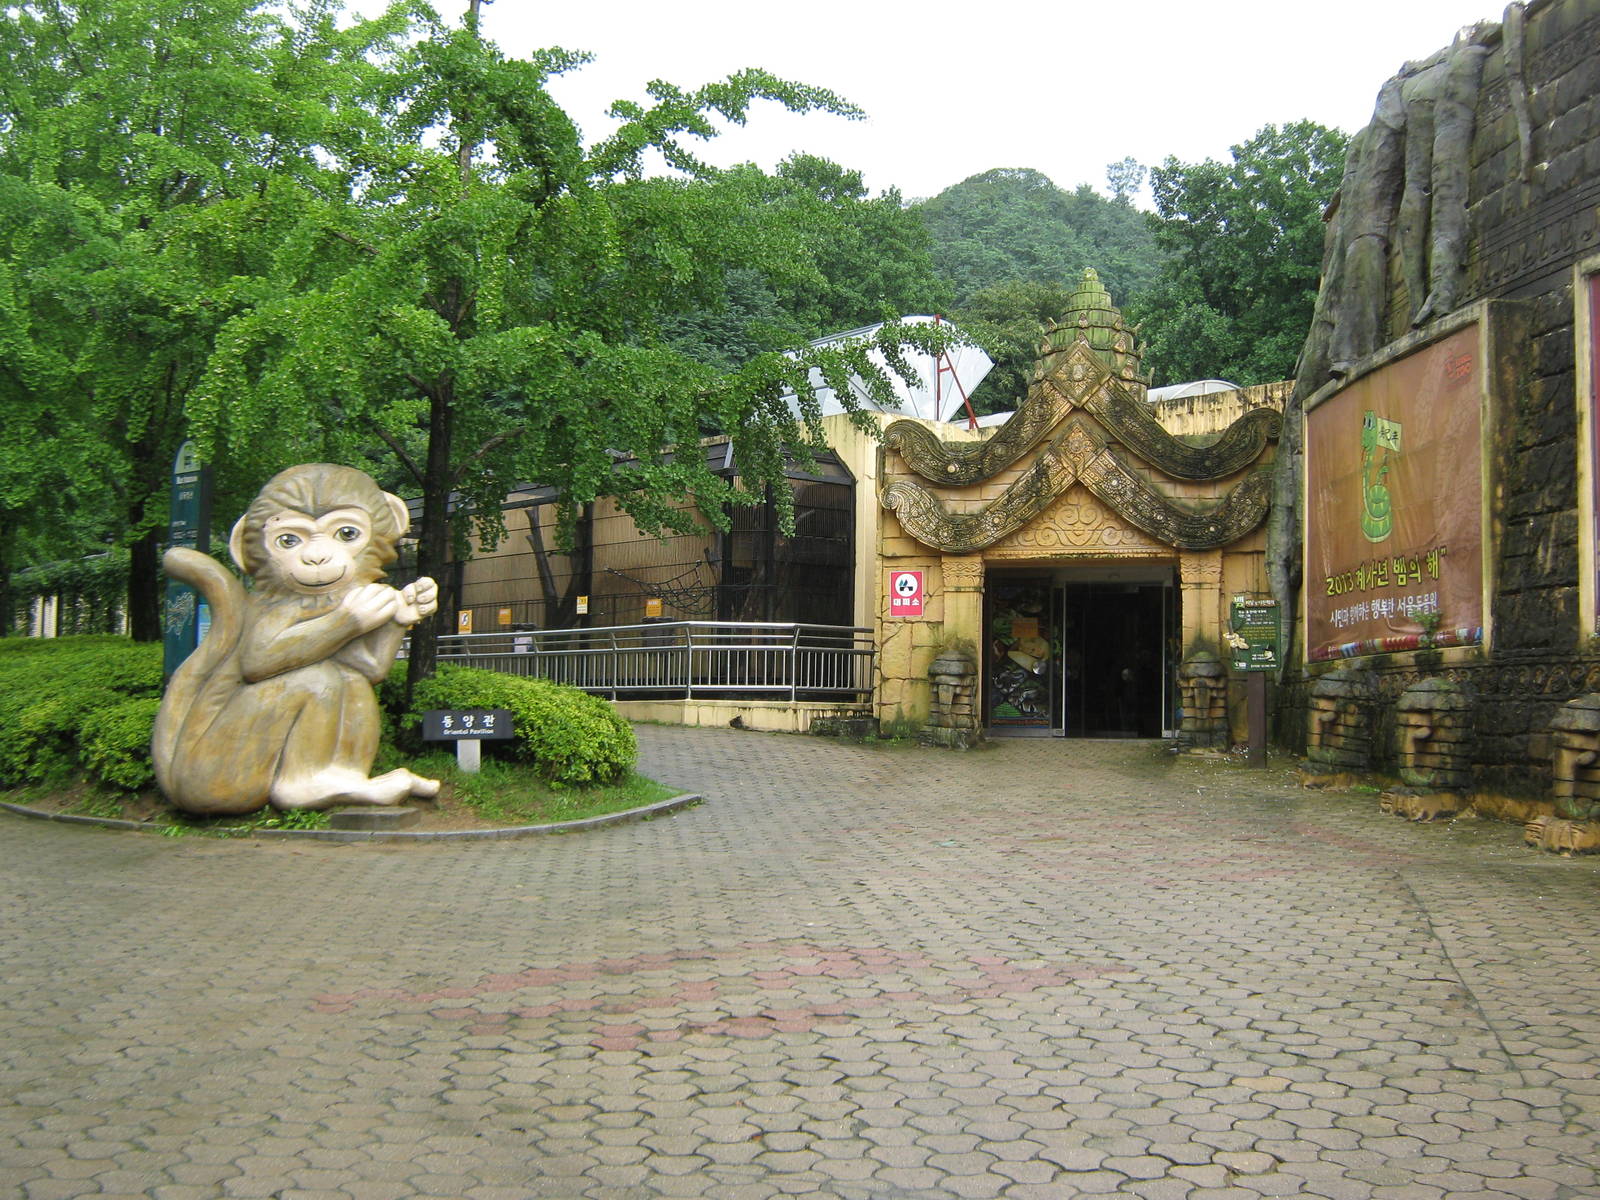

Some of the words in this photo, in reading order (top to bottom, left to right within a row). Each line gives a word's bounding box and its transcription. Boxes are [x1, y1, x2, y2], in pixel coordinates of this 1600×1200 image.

[1326, 571, 1354, 597] 2013
[1355, 558, 1389, 591] 계사년
[1393, 553, 1422, 586] 뱀의
[893, 597, 920, 606] 대피소
[1330, 608, 1349, 628] 시민과
[1371, 597, 1395, 619] 행복한
[1397, 591, 1438, 617] 서울동물원
